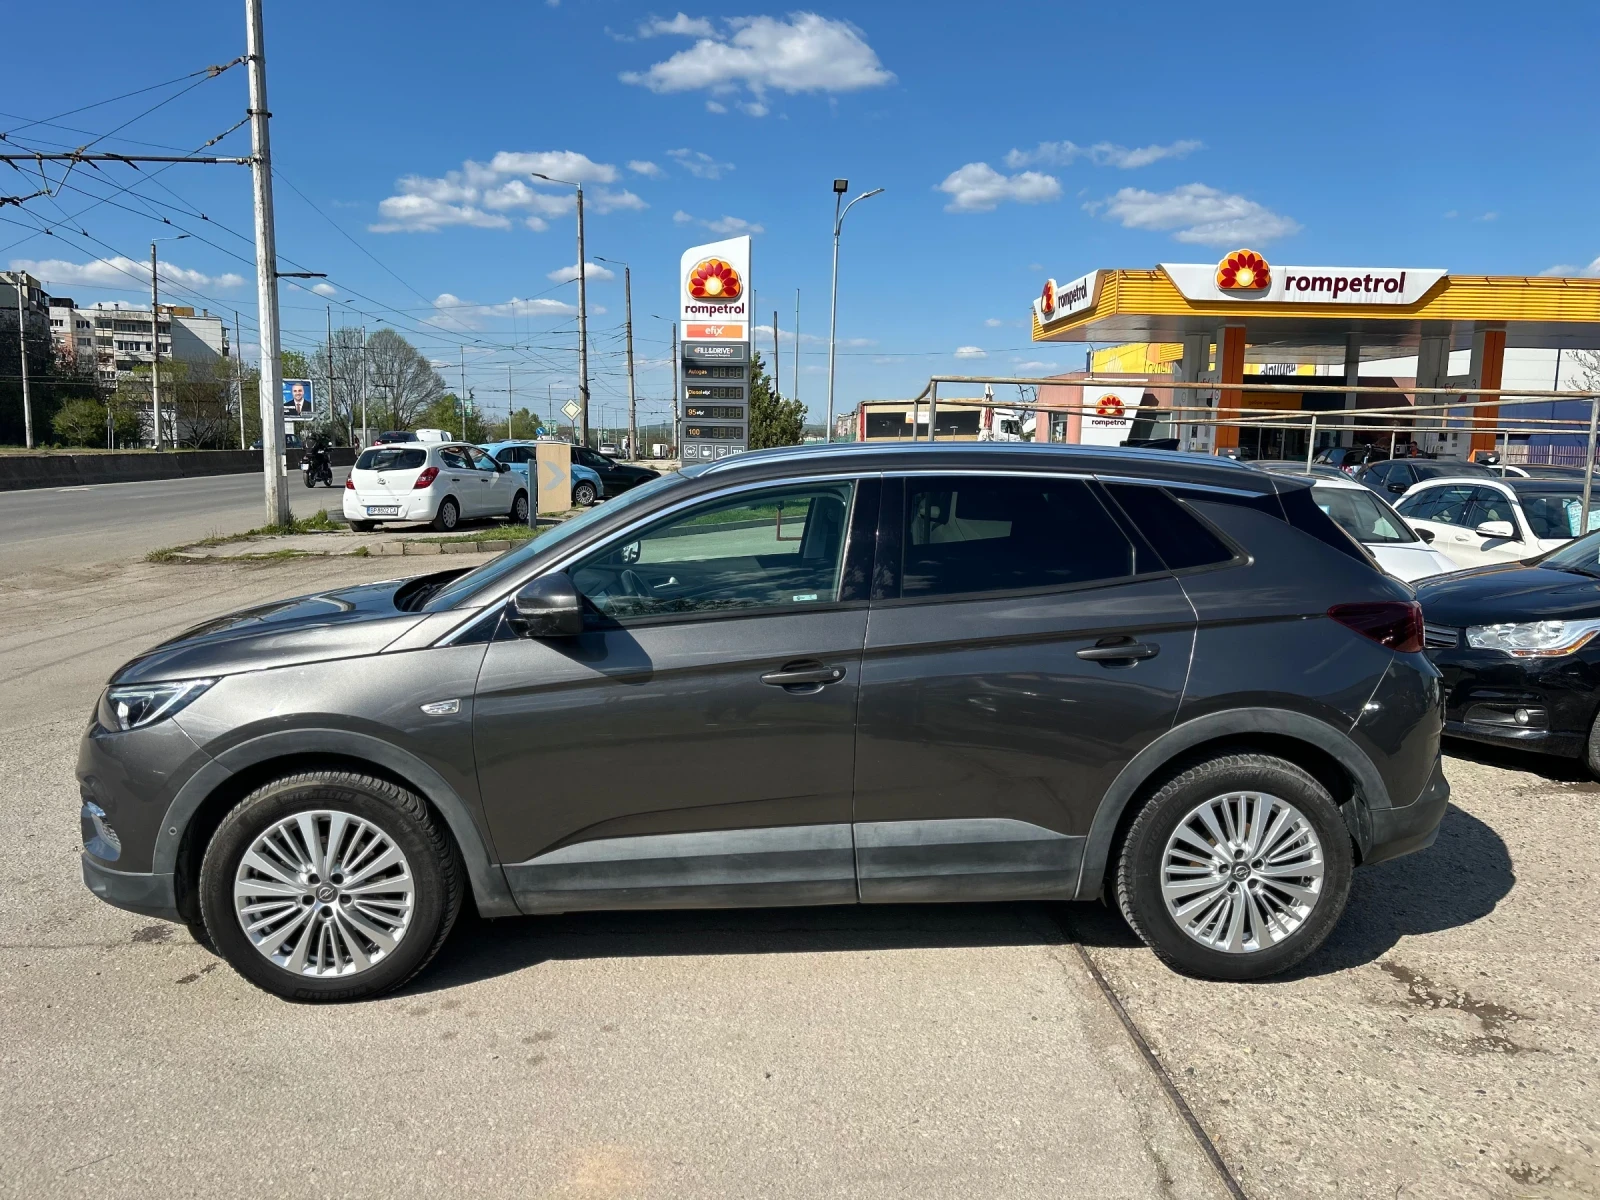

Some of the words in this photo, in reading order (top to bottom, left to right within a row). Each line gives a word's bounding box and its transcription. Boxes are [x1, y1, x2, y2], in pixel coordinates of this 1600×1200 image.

[1285, 271, 1406, 299] rompetrol
[1058, 277, 1088, 310] rompetrol
[685, 302, 745, 318] rompetrol
[704, 325, 725, 337] efix
[688, 408, 697, 416] 95
[1091, 419, 1127, 428] rompetrol
[688, 428, 701, 436] 100
